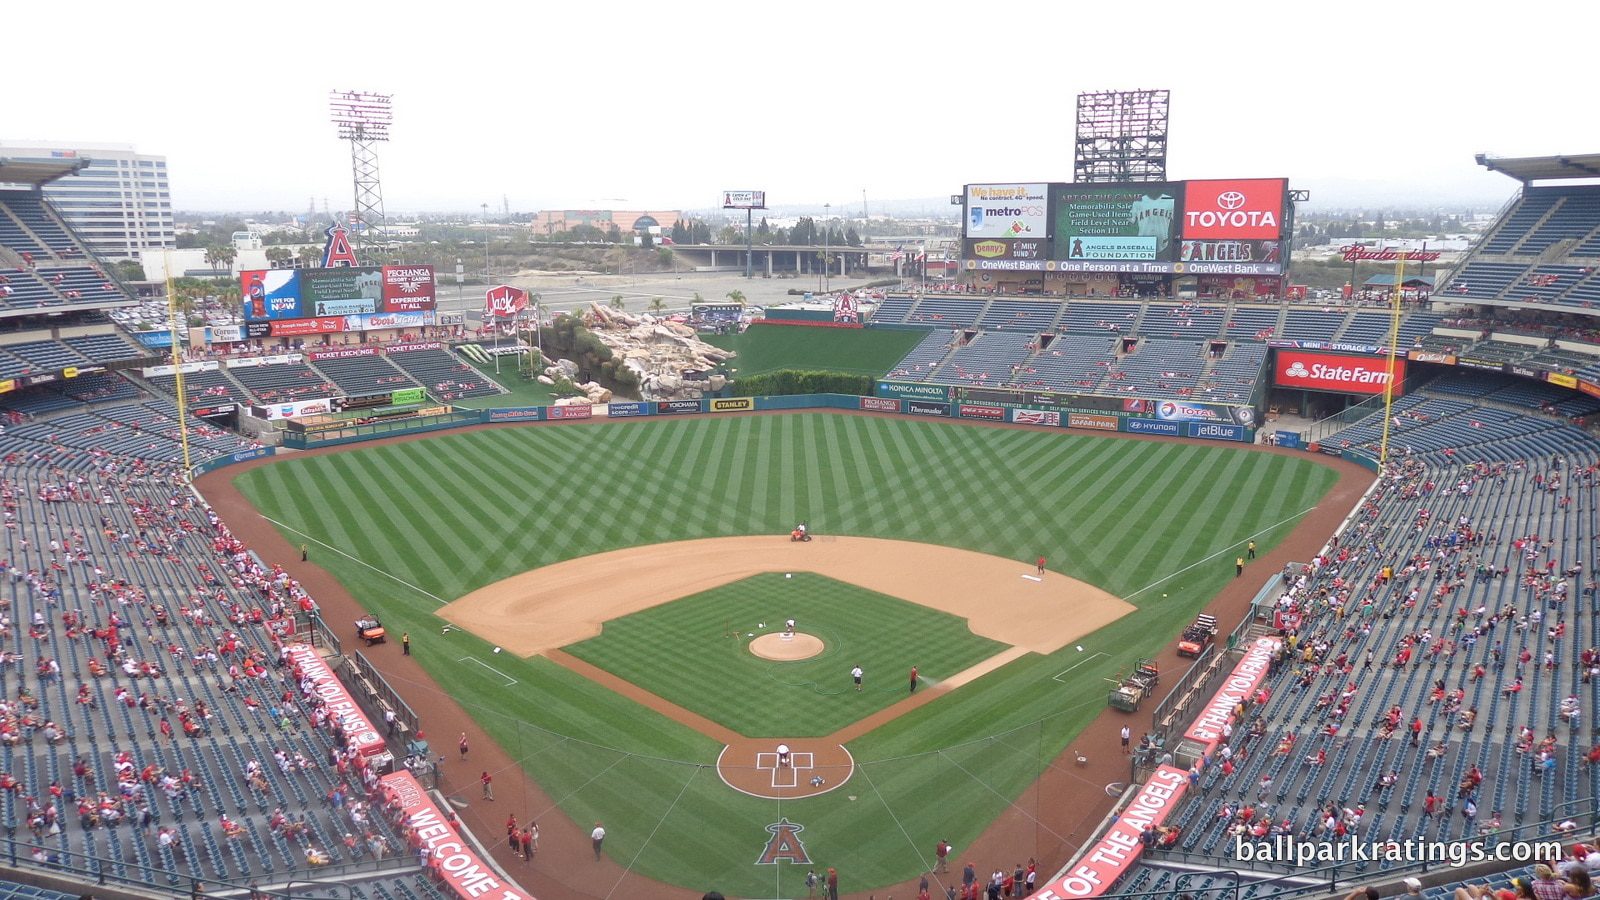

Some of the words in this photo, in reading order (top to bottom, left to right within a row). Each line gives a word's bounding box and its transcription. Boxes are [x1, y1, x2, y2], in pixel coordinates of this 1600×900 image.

[971, 187, 987, 196] We
[989, 187, 1015, 196] have
[986, 206, 1043, 216] metroPCS
[1187, 211, 1276, 227] TOYOTA
[976, 244, 1004, 253] Denny's
[982, 261, 1018, 269] OneWest
[1020, 261, 1040, 270] Bank
[1060, 262, 1080, 270] One
[1083, 262, 1117, 271] Person
[1120, 263, 1130, 271] at
[1142, 262, 1168, 272] Time
[1190, 264, 1234, 272] OneWest
[1235, 264, 1259, 273] Bank
[490, 290, 516, 314] Jack
[370, 316, 395, 326] Coors
[1332, 343, 1366, 352] STORAGE
[315, 351, 339, 359] TICKET
[910, 406, 942, 415] Thermador
[1180, 407, 1216, 417] TOTAL
[1143, 422, 1176, 432] HYUNDAI
[1198, 425, 1234, 437] jetBlue
[294, 650, 333, 682] THANK
[316, 680, 346, 702] YOU
[1198, 691, 1244, 730] THANK
[1224, 672, 1256, 693] YOU
[1062, 866, 1102, 896] OF
[1090, 830, 1139, 866] THE
[1122, 770, 1187, 832] ANGELS
[410, 807, 500, 898] WELCOME
